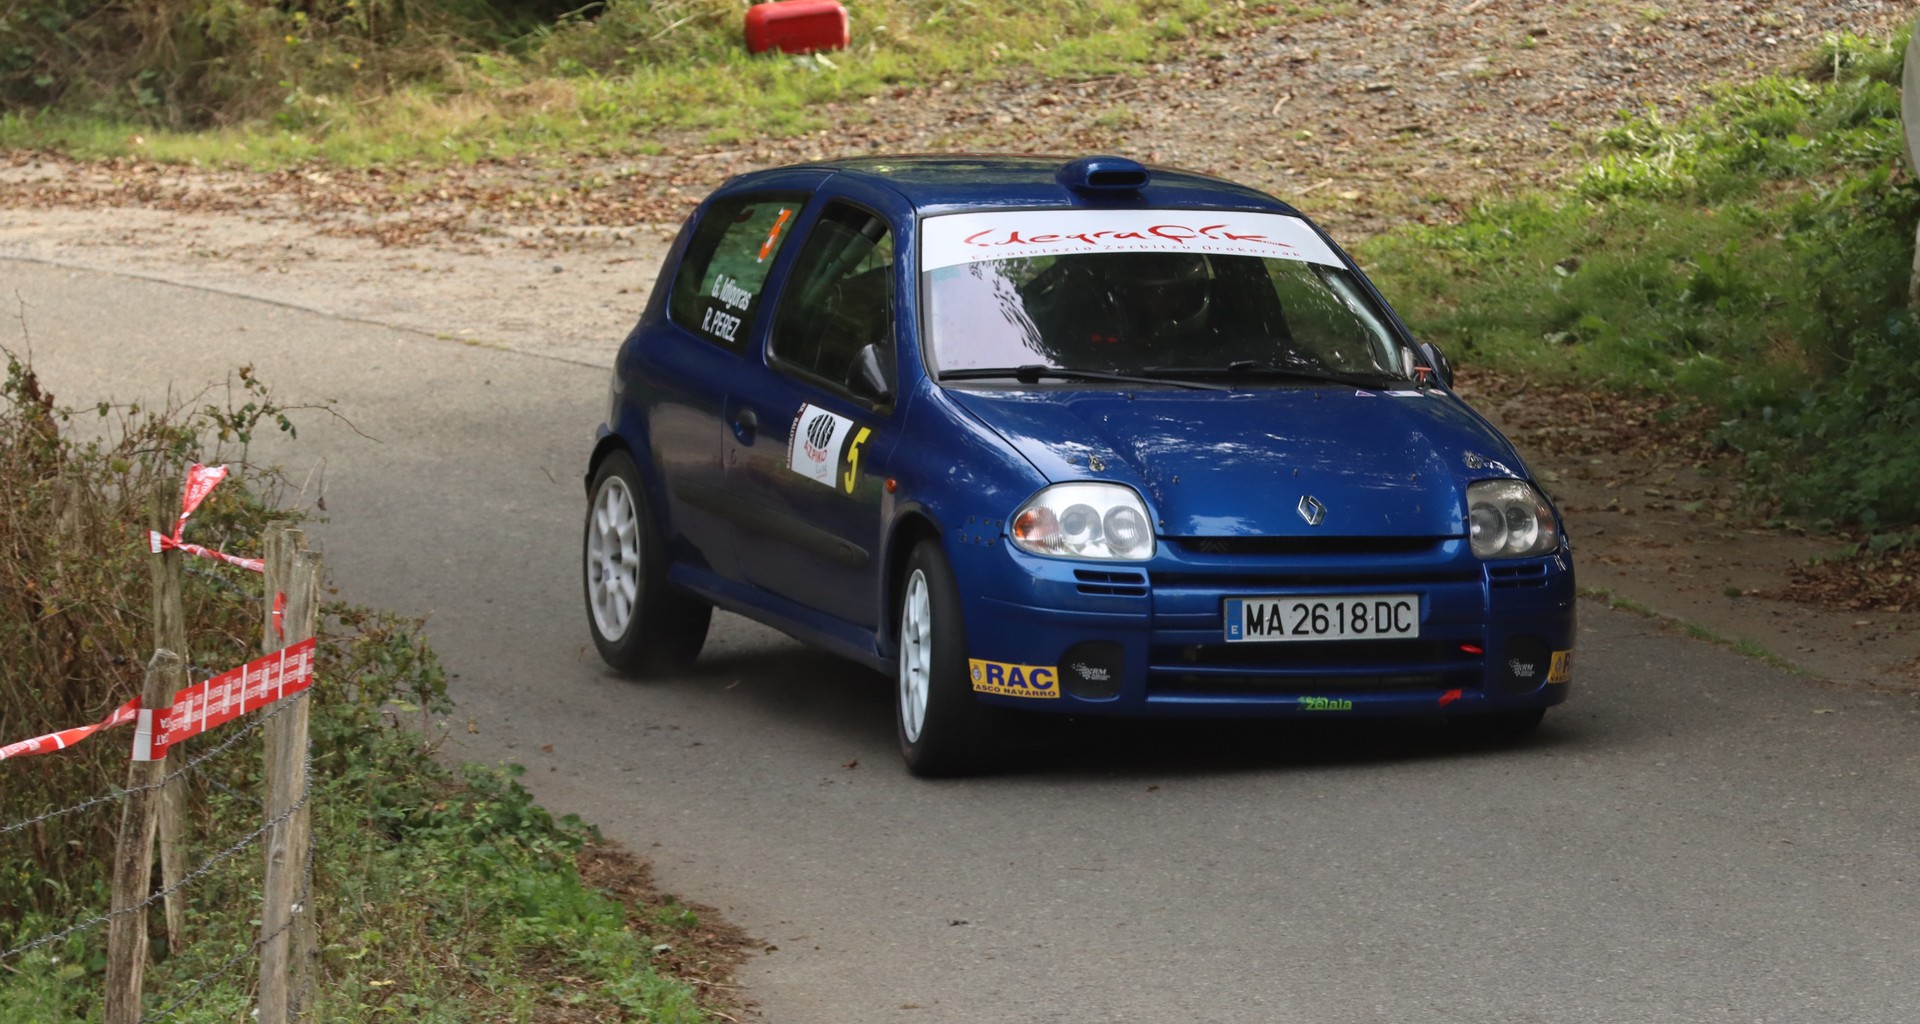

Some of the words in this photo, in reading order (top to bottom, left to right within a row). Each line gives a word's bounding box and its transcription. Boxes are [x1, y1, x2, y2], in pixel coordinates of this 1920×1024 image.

[710, 310, 741, 343] PEREZ
[844, 426, 871, 494] 5
[1231, 625, 1239, 635] E
[1246, 603, 1285, 636] MA
[1292, 602, 1368, 635] 2618
[1375, 601, 1411, 633] DC
[985, 663, 1054, 691] RAC
[1003, 688, 1057, 698] NAVARRO
